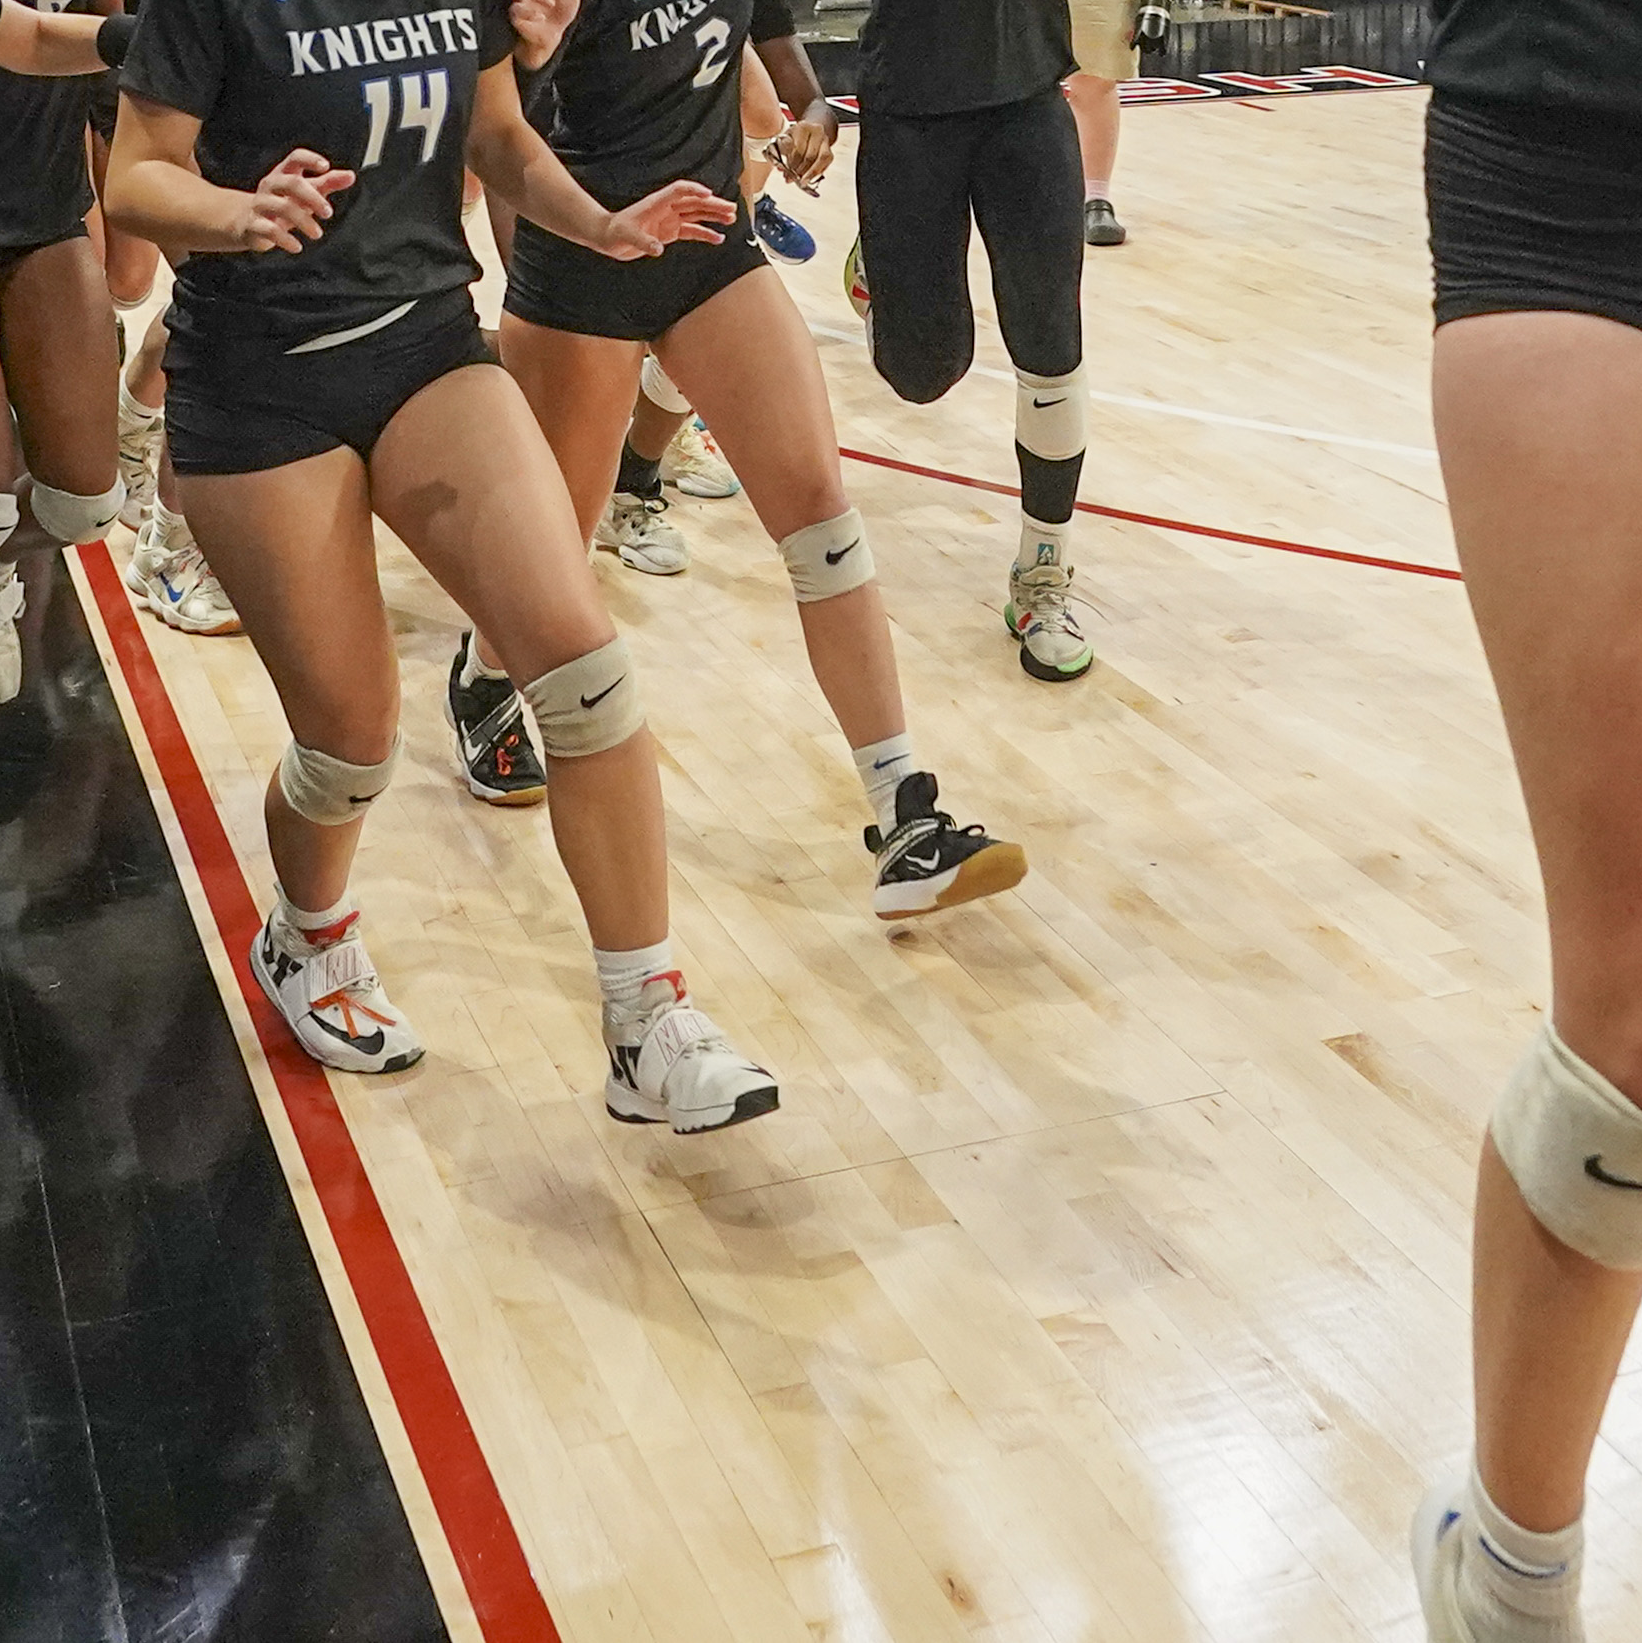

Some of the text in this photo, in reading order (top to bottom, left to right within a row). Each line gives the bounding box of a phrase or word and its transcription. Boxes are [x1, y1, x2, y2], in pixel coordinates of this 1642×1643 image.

[286, 8, 478, 76] KNIGHTS
[692, 17, 732, 90] 2
[360, 68, 450, 170] 14
